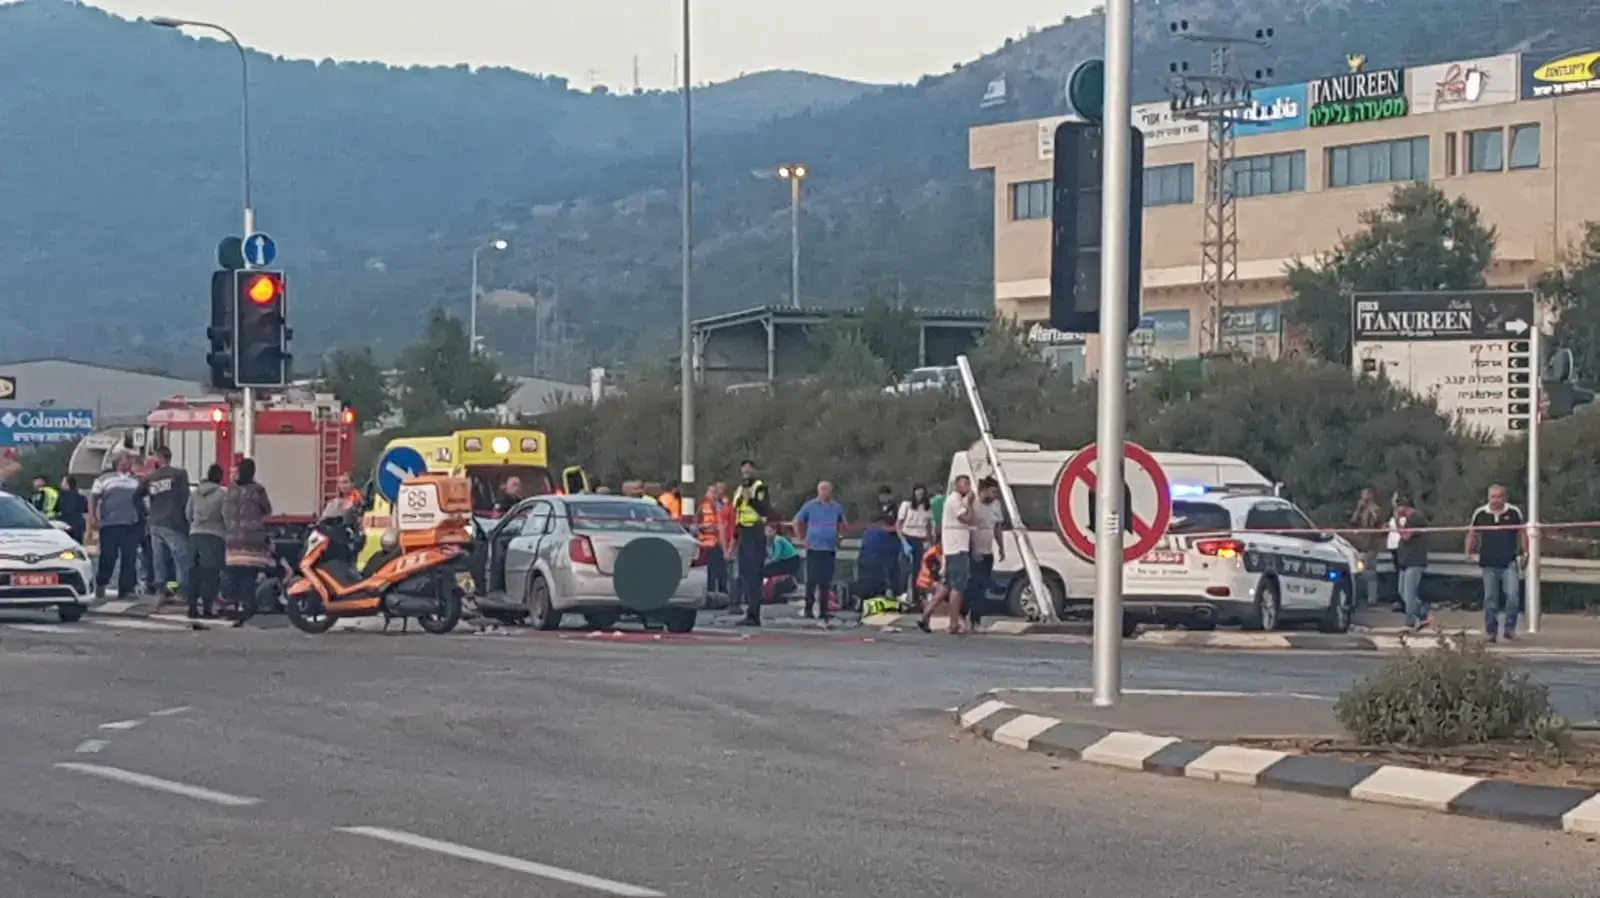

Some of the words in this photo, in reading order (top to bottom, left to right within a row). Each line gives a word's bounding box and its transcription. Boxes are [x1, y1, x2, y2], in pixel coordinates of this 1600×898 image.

[1310, 69, 1399, 105] TANUREEN
[1356, 97, 1405, 121] מסעדה
[1361, 311, 1472, 330] TANUREEN
[17, 411, 92, 428] Columbia
